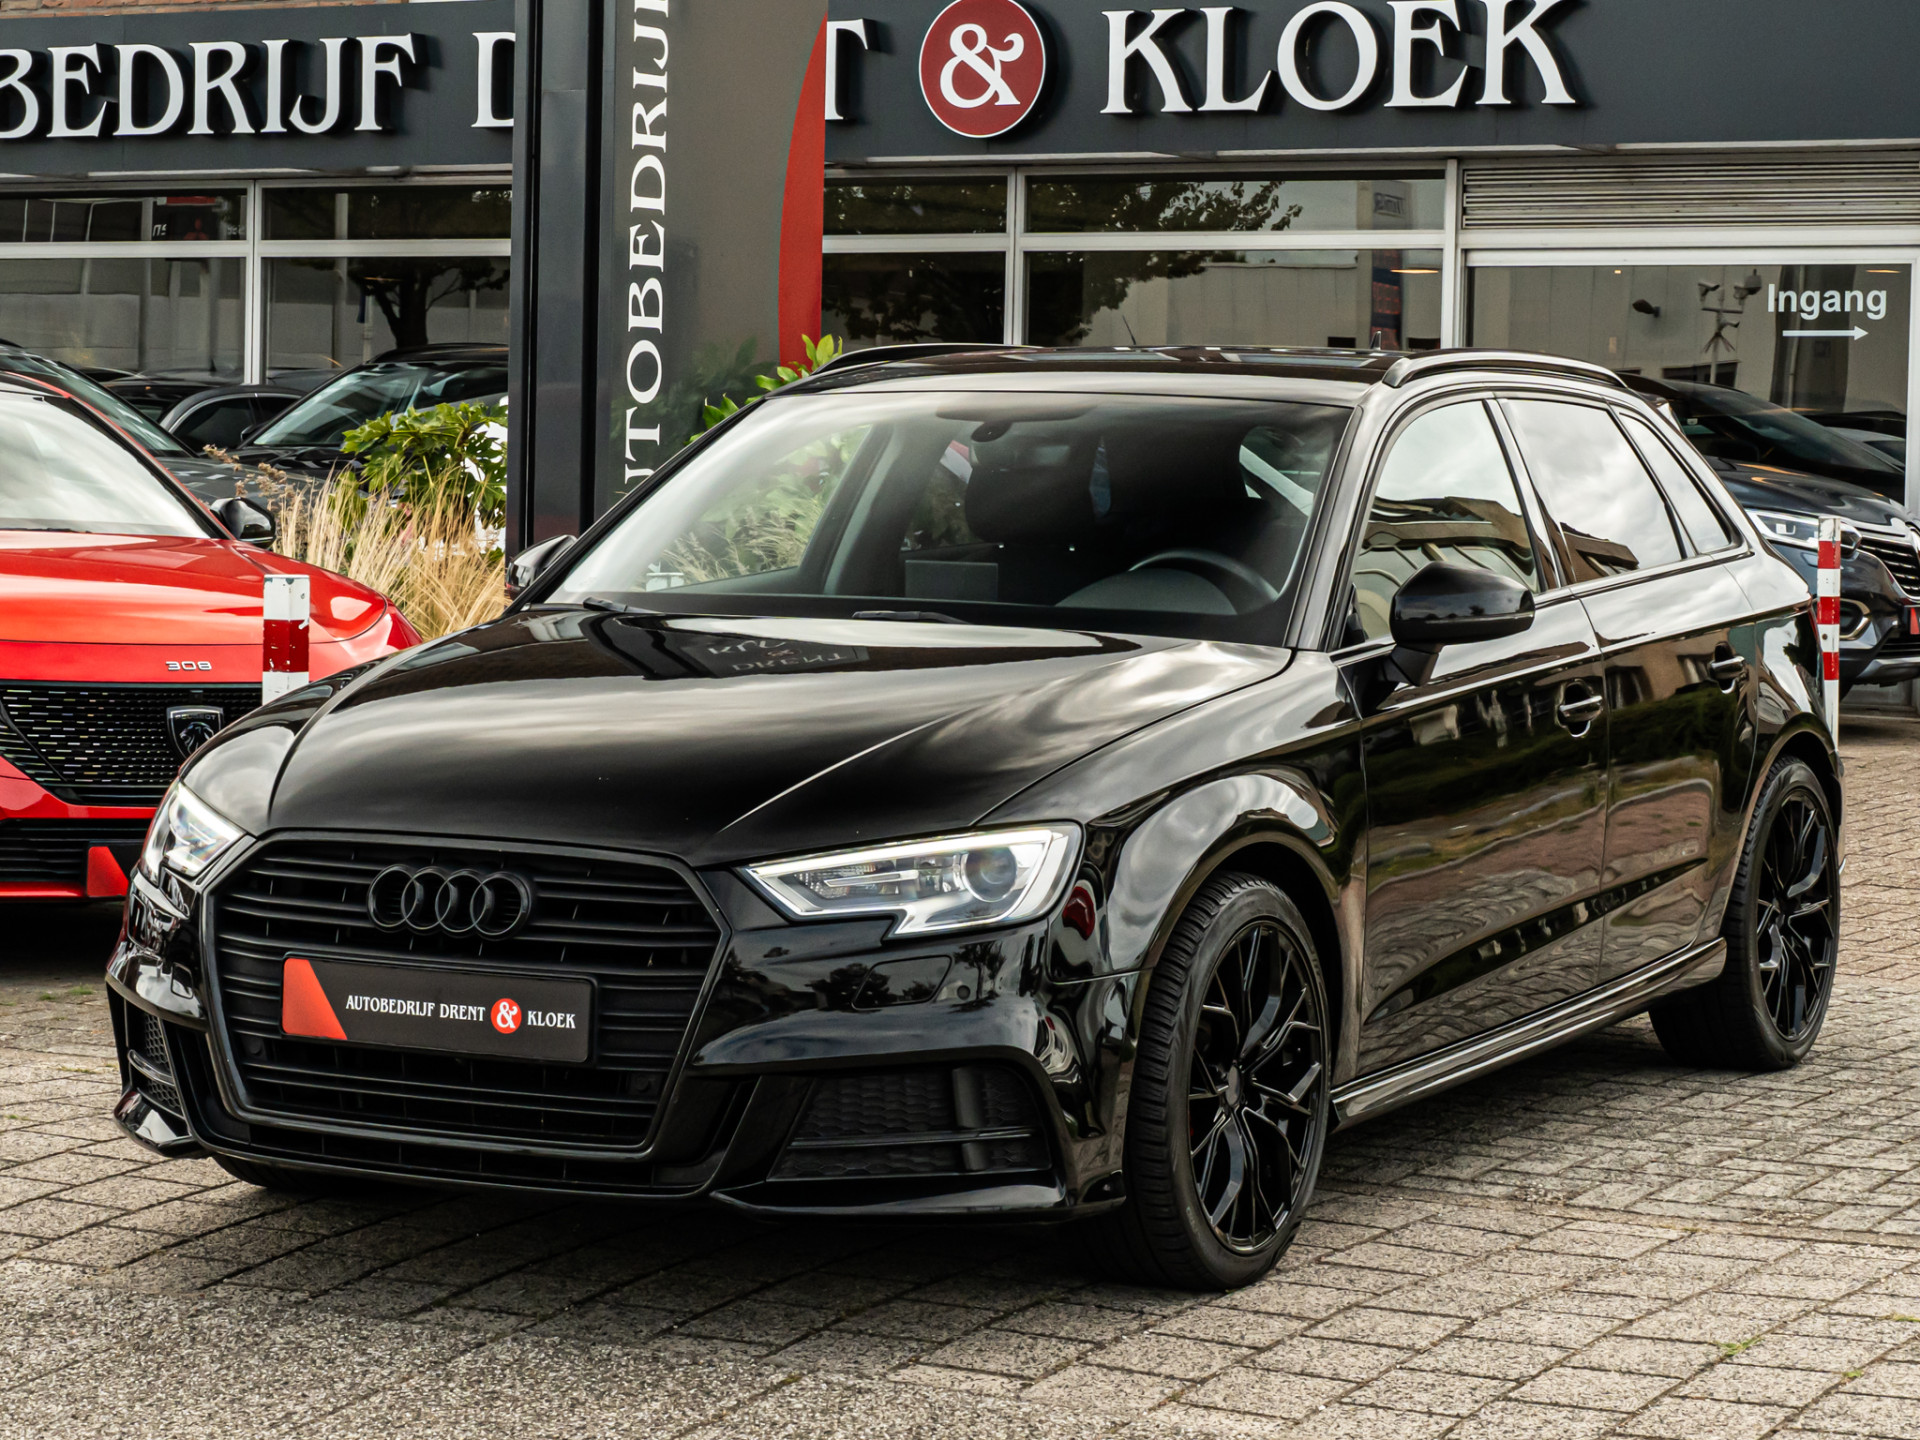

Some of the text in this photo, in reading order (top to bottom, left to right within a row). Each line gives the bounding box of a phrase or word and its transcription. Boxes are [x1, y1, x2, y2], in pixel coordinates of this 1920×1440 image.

[940, 23, 1025, 108] &
[1100, 0, 1576, 114] KLOEK
[1767, 283, 1887, 321] Ingang
[165, 660, 213, 671] 308
[345, 995, 577, 1029] AUTOBEDRIJF DRENT & KLOEK
